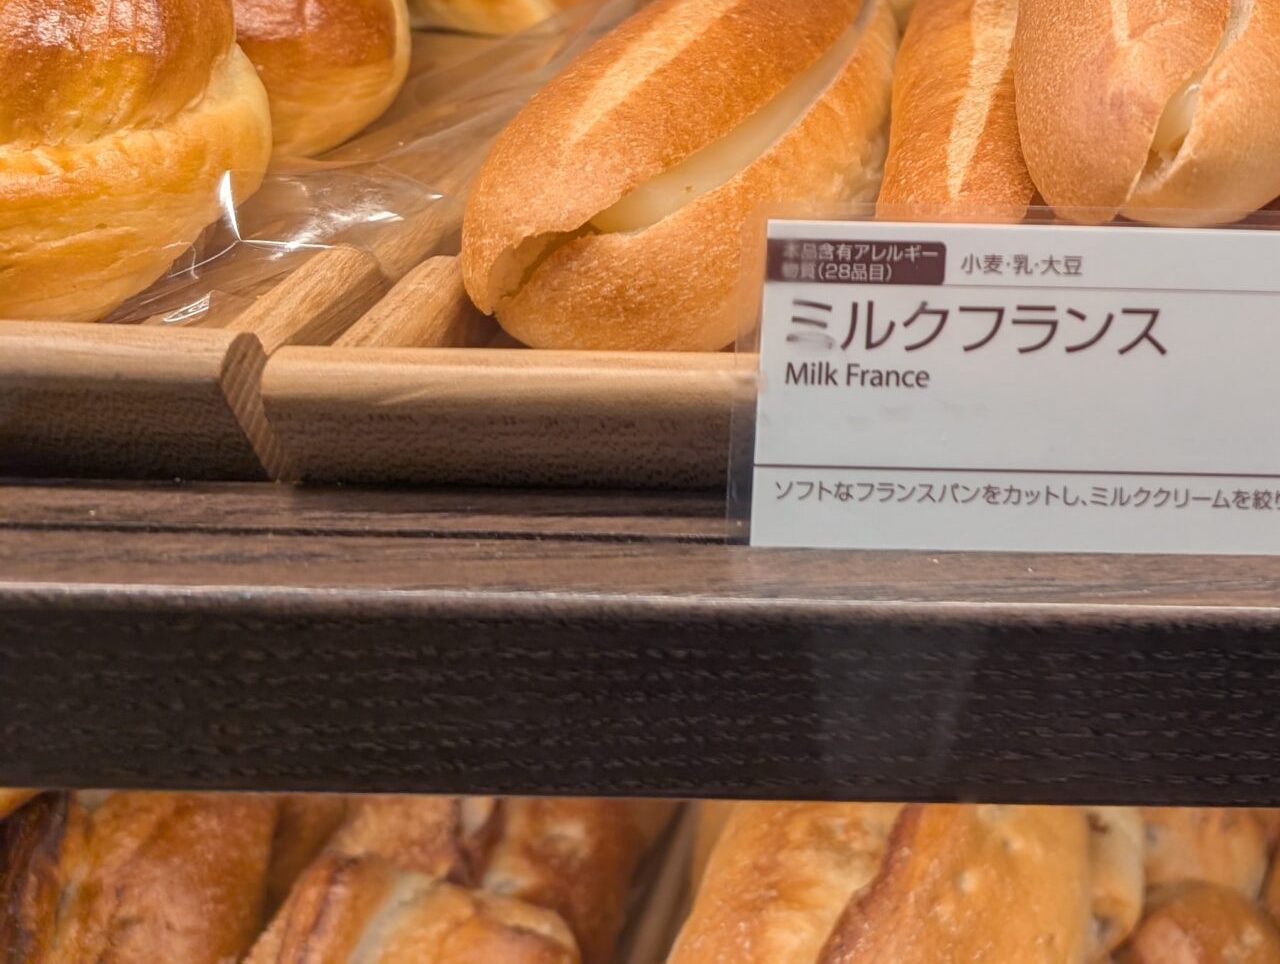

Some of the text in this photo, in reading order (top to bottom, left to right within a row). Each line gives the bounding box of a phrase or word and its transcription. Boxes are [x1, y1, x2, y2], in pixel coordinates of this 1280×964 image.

[785, 299, 1168, 356] ミルクフランス
[785, 362, 930, 389] Milk France
